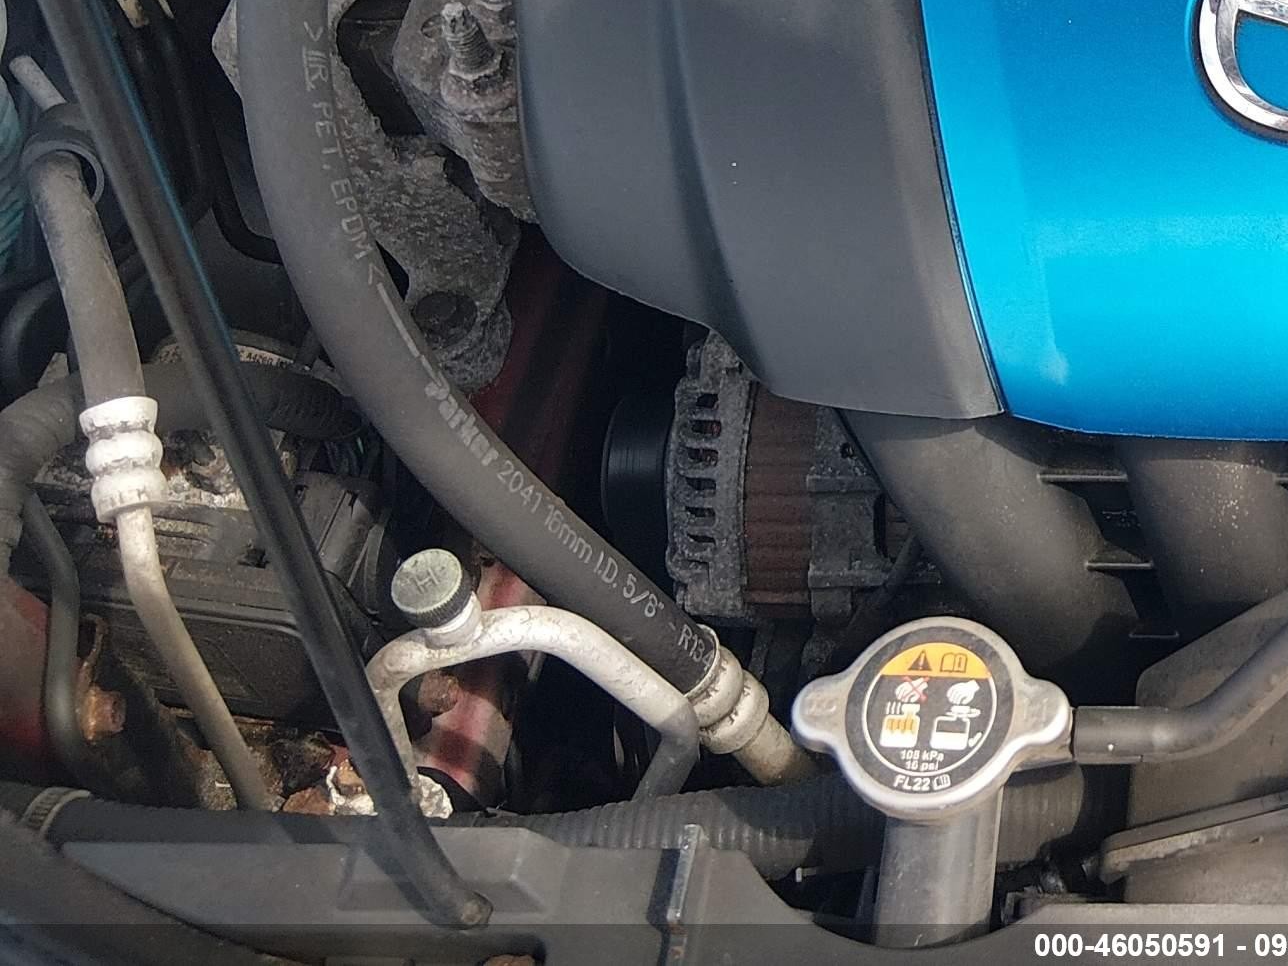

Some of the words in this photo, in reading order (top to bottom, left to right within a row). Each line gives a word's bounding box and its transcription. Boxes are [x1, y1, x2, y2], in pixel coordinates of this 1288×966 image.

[424, 381, 500, 467] Parker
[496, 459, 543, 514] 2041
[544, 503, 593, 564] 16mm
[593, 550, 619, 589] I.D.
[922, 750, 944, 762] kPa
[893, 774, 931, 791] FL22
